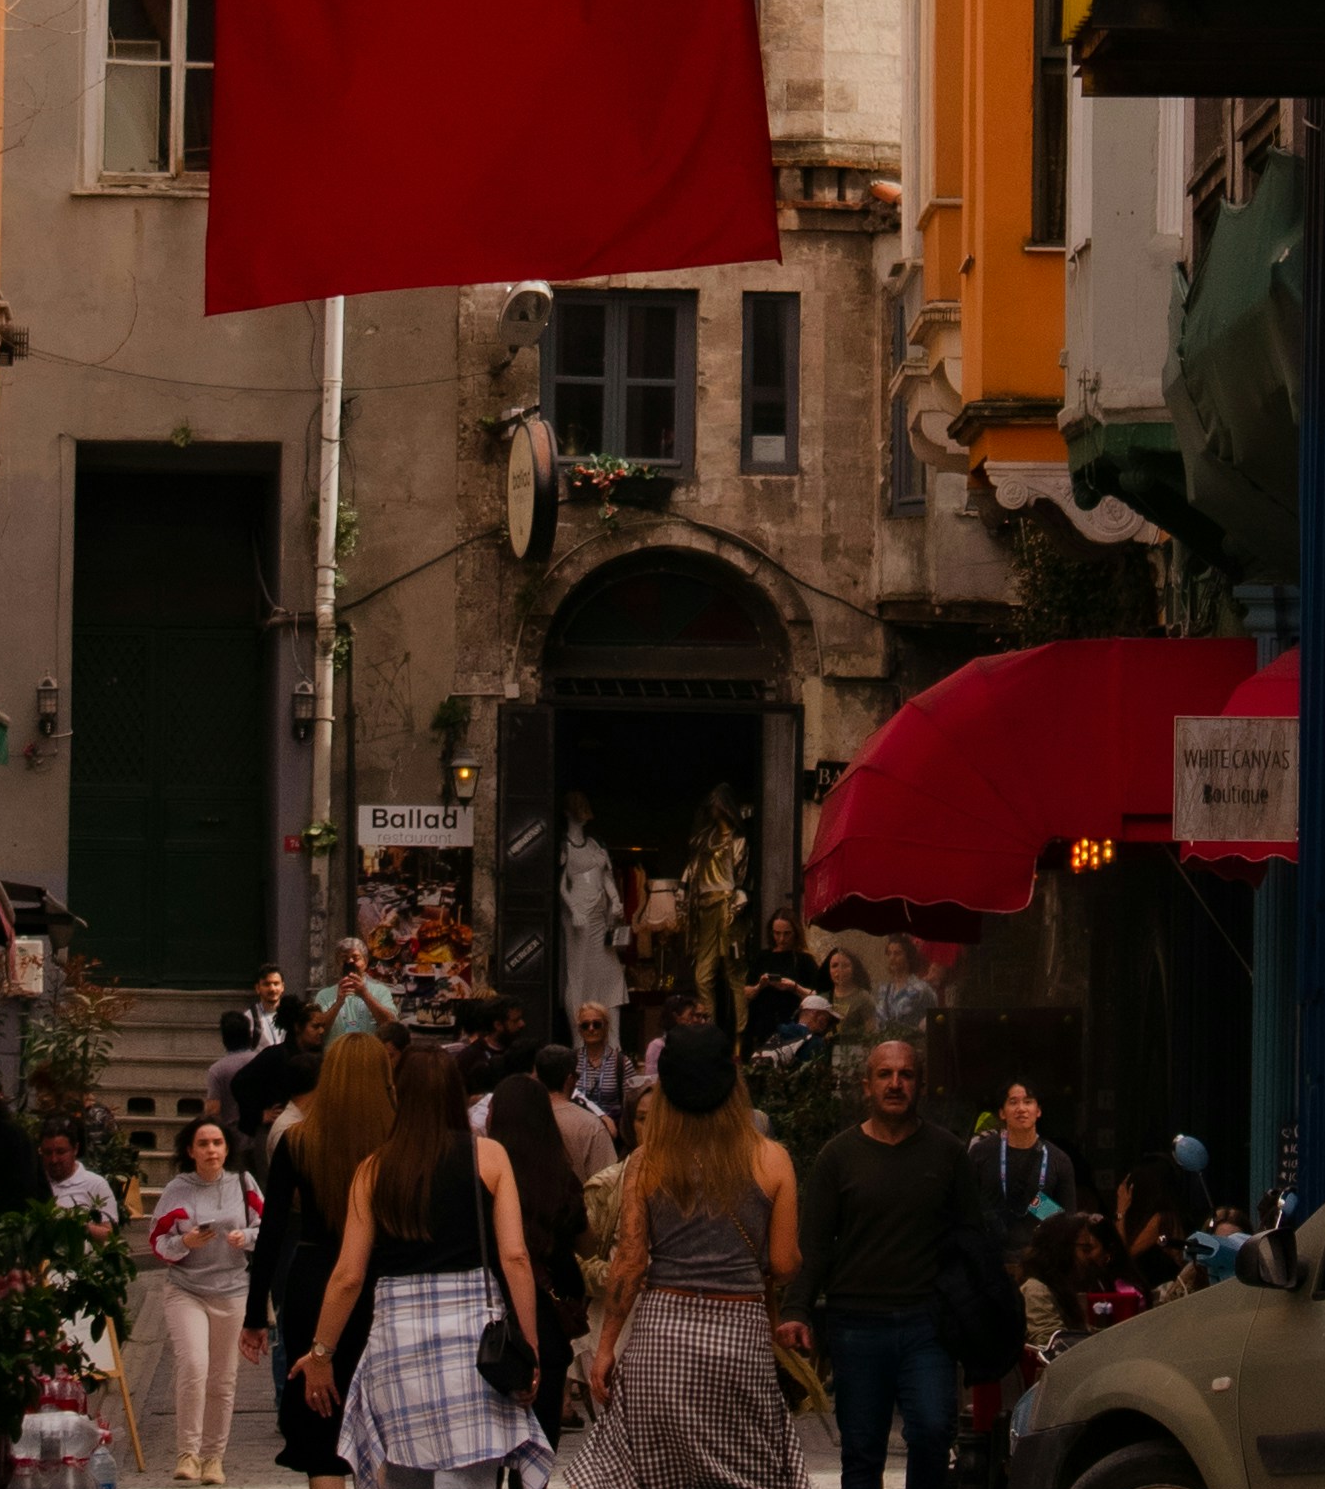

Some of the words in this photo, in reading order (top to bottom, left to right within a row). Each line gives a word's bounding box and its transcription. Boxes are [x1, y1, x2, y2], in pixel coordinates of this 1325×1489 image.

[1183, 749, 1229, 769] WHITE
[1232, 749, 1290, 770] CANVAS
[1202, 784, 1269, 808] Boutique
[372, 808, 458, 830] Ballad
[376, 831, 453, 845] restaurant
